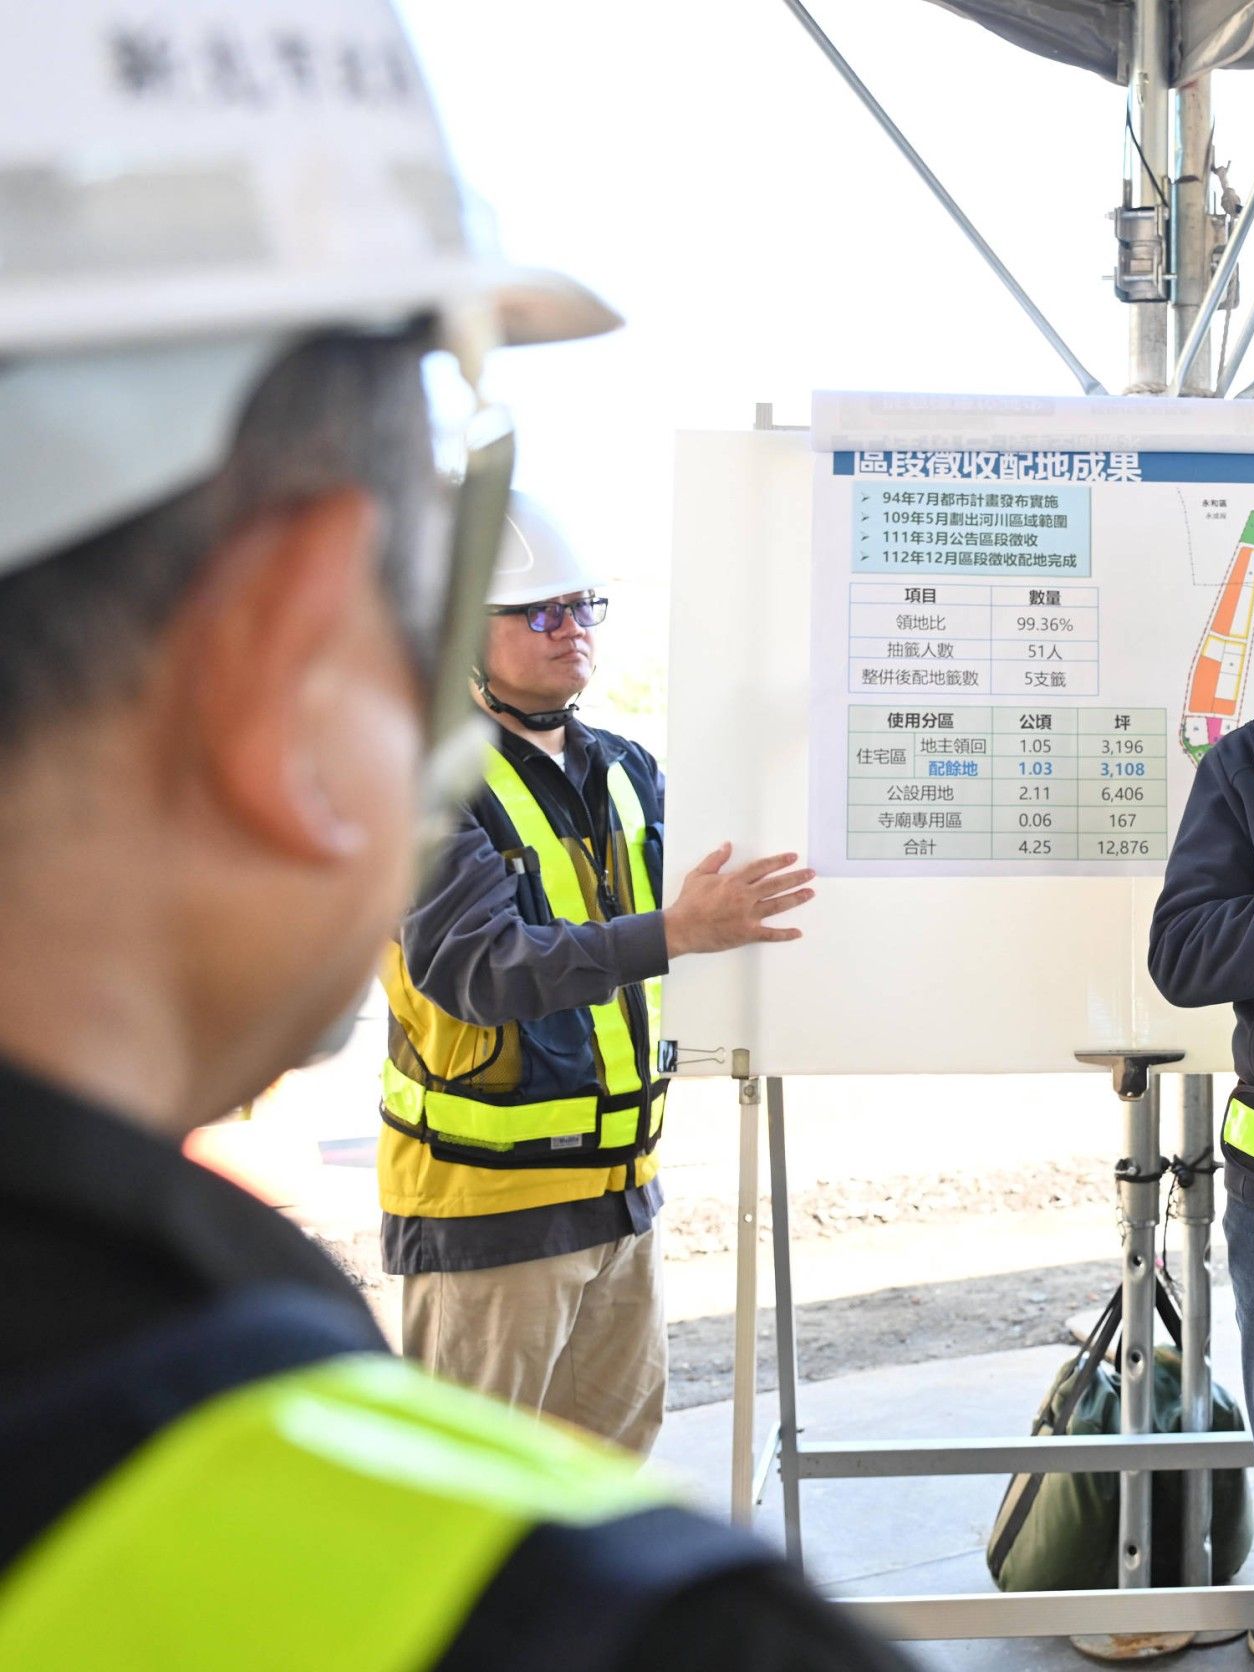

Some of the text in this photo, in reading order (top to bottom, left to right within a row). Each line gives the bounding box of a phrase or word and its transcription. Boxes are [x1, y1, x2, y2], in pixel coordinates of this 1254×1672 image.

[854, 451, 1142, 482] 區段徵收配地成果
[883, 492, 1059, 509] 94年7月都市計畫發布實施
[883, 511, 1068, 529] 109年5月劃出河川區域範圍
[883, 531, 1038, 547] 111年3月公告區段徵收
[883, 551, 1077, 568] 112年12月區段徵收配地完成
[905, 588, 1061, 606] 項目 數量
[896, 614, 1074, 632] 領地比 99.36%
[887, 641, 1063, 660] 抽籤人數 51人
[1024, 671, 1067, 688] 5支籤
[887, 712, 1131, 731] 使用分區 公頃 坪
[856, 737, 1144, 765] 住宅區 地主領回 1.05 3,196
[928, 759, 1145, 778] 配餘地 1.03 3,108
[886, 784, 1144, 803] 公設用地 2.11 6,406
[878, 811, 1137, 829] 寺廟專用區 0.06 167
[903, 838, 1149, 857] 合計 4.25 12,876
